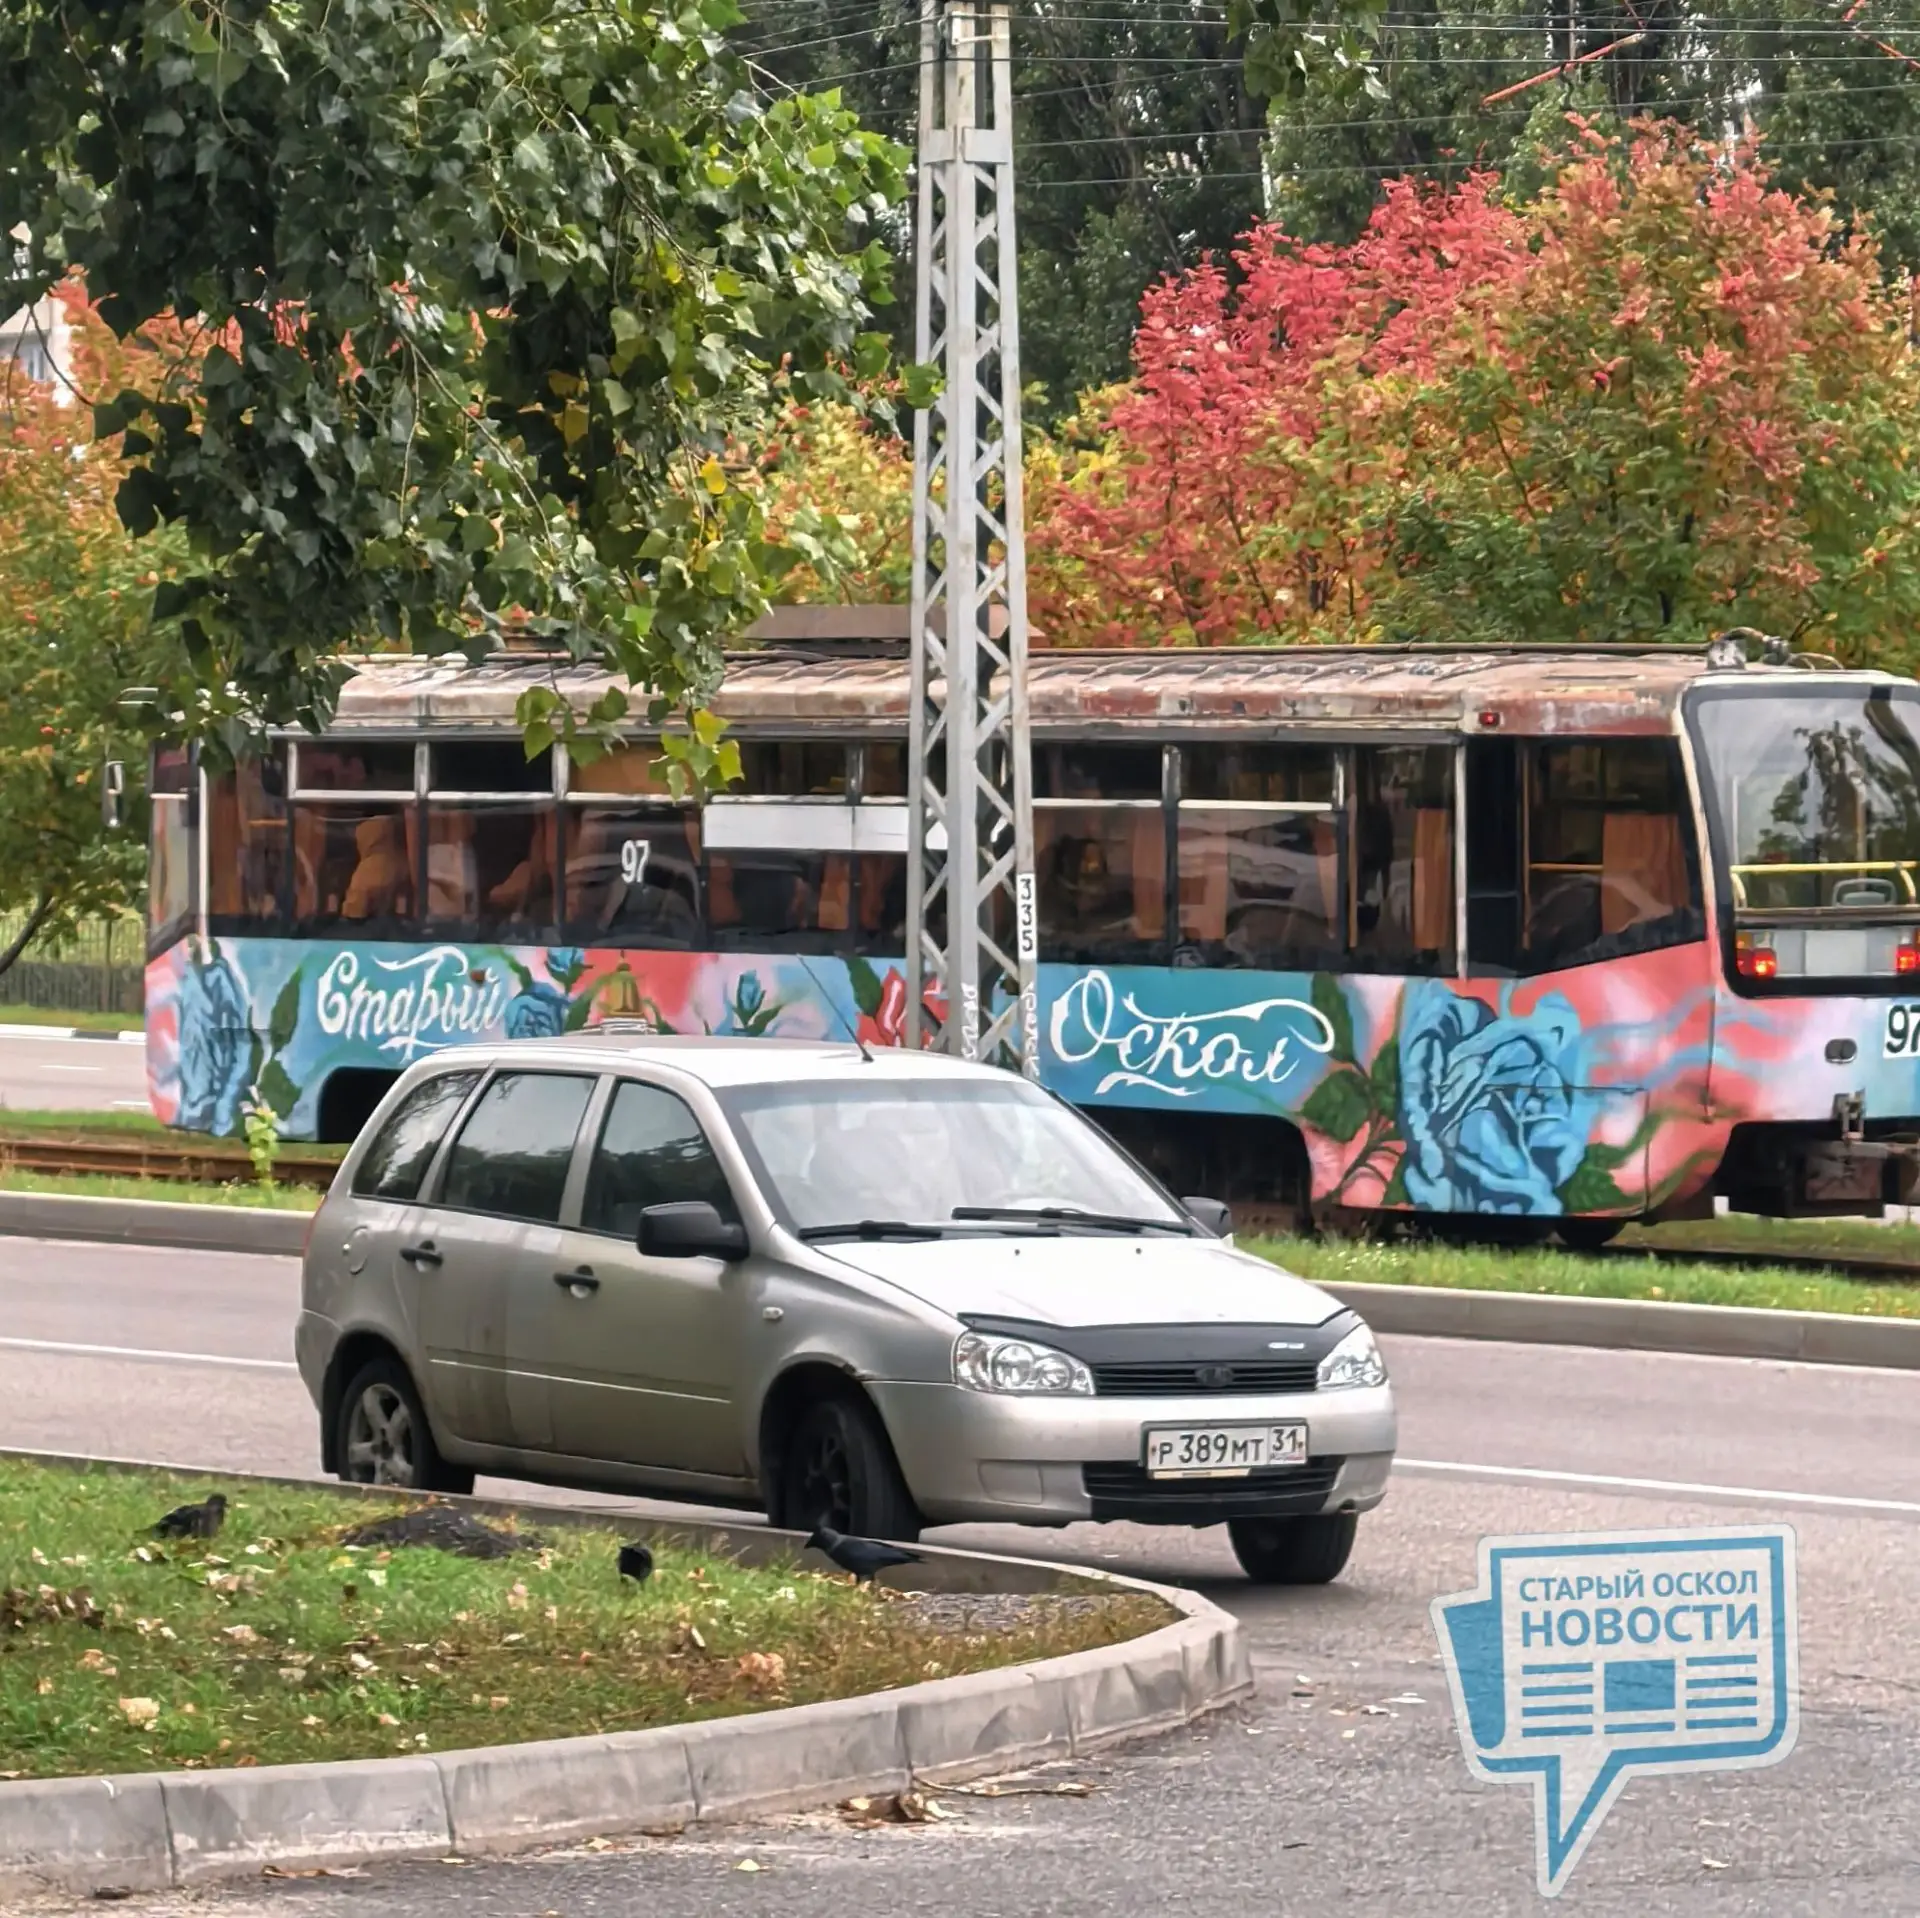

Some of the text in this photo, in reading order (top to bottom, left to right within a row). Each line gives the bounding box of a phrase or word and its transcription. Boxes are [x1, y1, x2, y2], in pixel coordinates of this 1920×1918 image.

[621, 839, 650, 883] 97
[1020, 877, 1034, 953] 335
[1050, 970, 1335, 1097] Оскол
